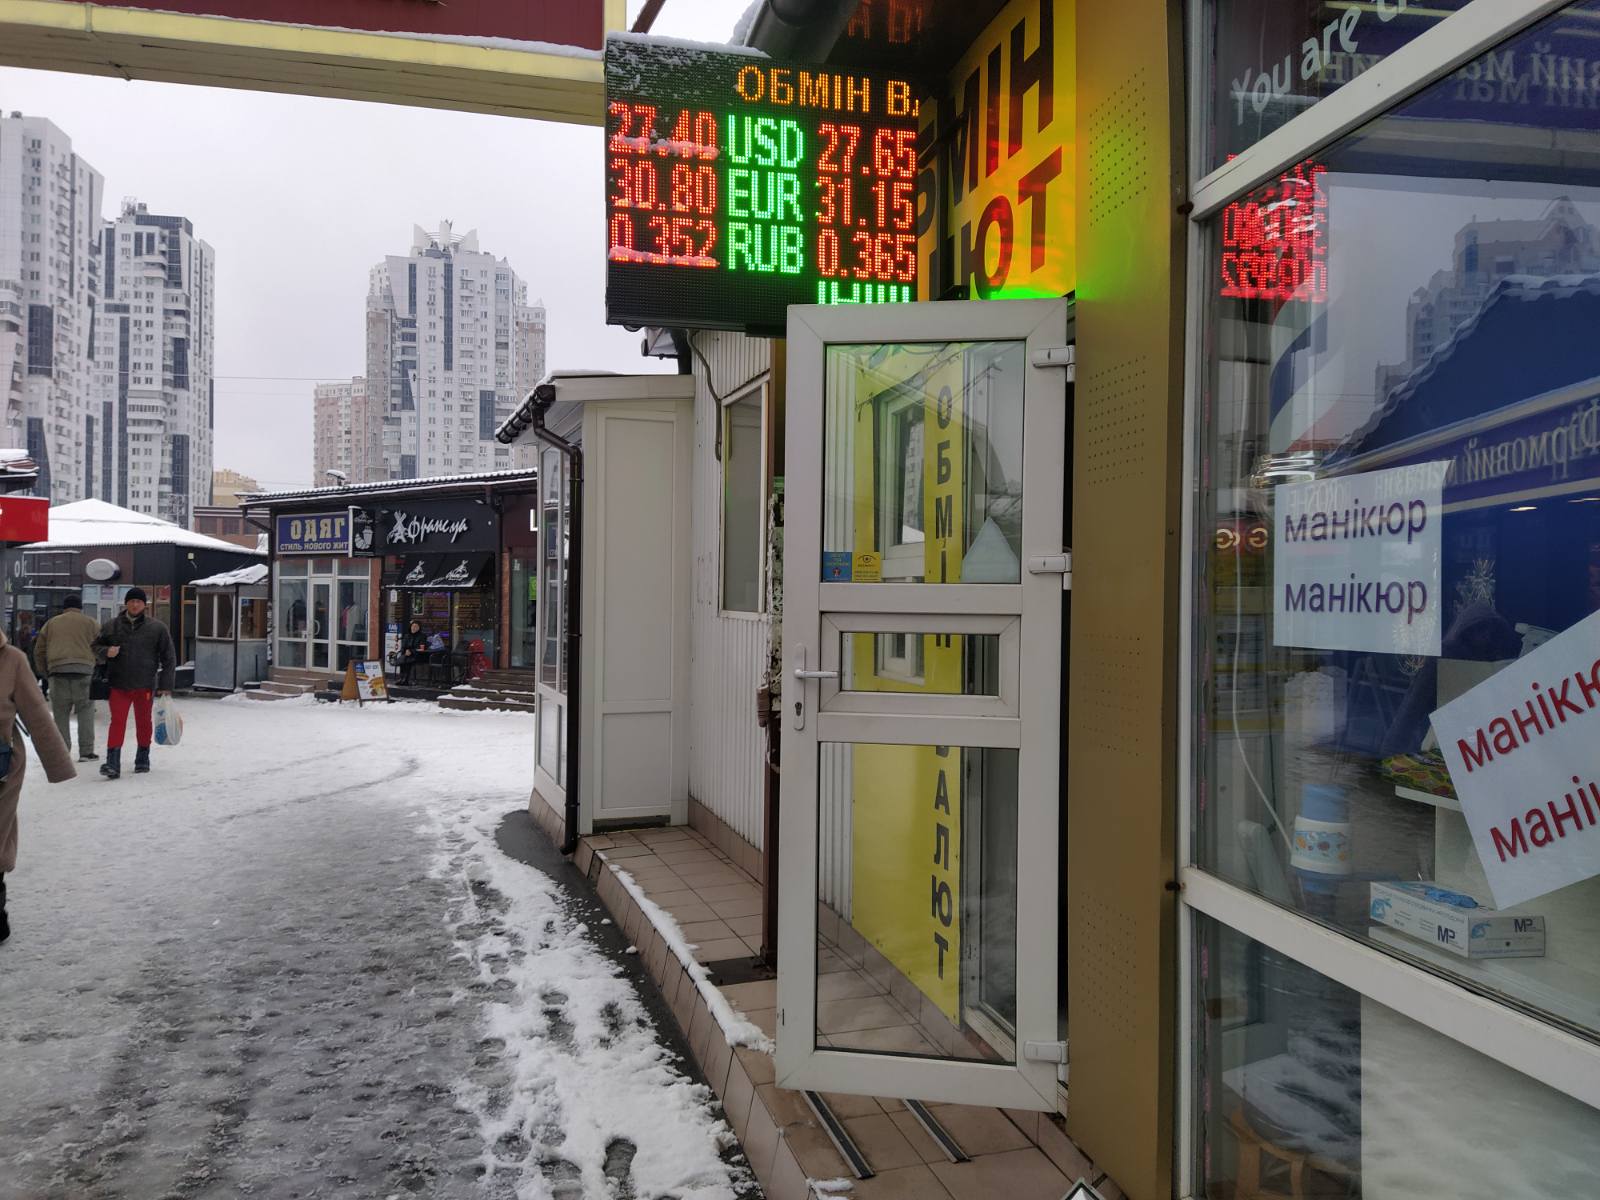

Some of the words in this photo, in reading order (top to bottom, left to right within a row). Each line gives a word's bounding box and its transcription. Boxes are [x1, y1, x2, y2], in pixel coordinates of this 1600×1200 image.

[736, 65, 870, 112] ОБМІН
[1232, 54, 1290, 125] You
[1301, 6, 1362, 80] are
[609, 101, 719, 160] 27.40
[728, 114, 804, 168] USD
[818, 123, 917, 178] 27.65
[609, 158, 718, 215] 30.80
[728, 168, 803, 222] EUR
[816, 176, 914, 230] 31.15
[609, 212, 719, 268] 0.352
[728, 222, 804, 274] RUB
[817, 228, 917, 281] 0.365
[280, 543, 303, 551] СТИЛЬ
[304, 541, 332, 550] НОВОГО
[290, 518, 345, 542] ОДЯГ
[1284, 499, 1428, 545] манікюр
[1284, 573, 1428, 625] манікюр
[1489, 775, 1600, 863] мані
